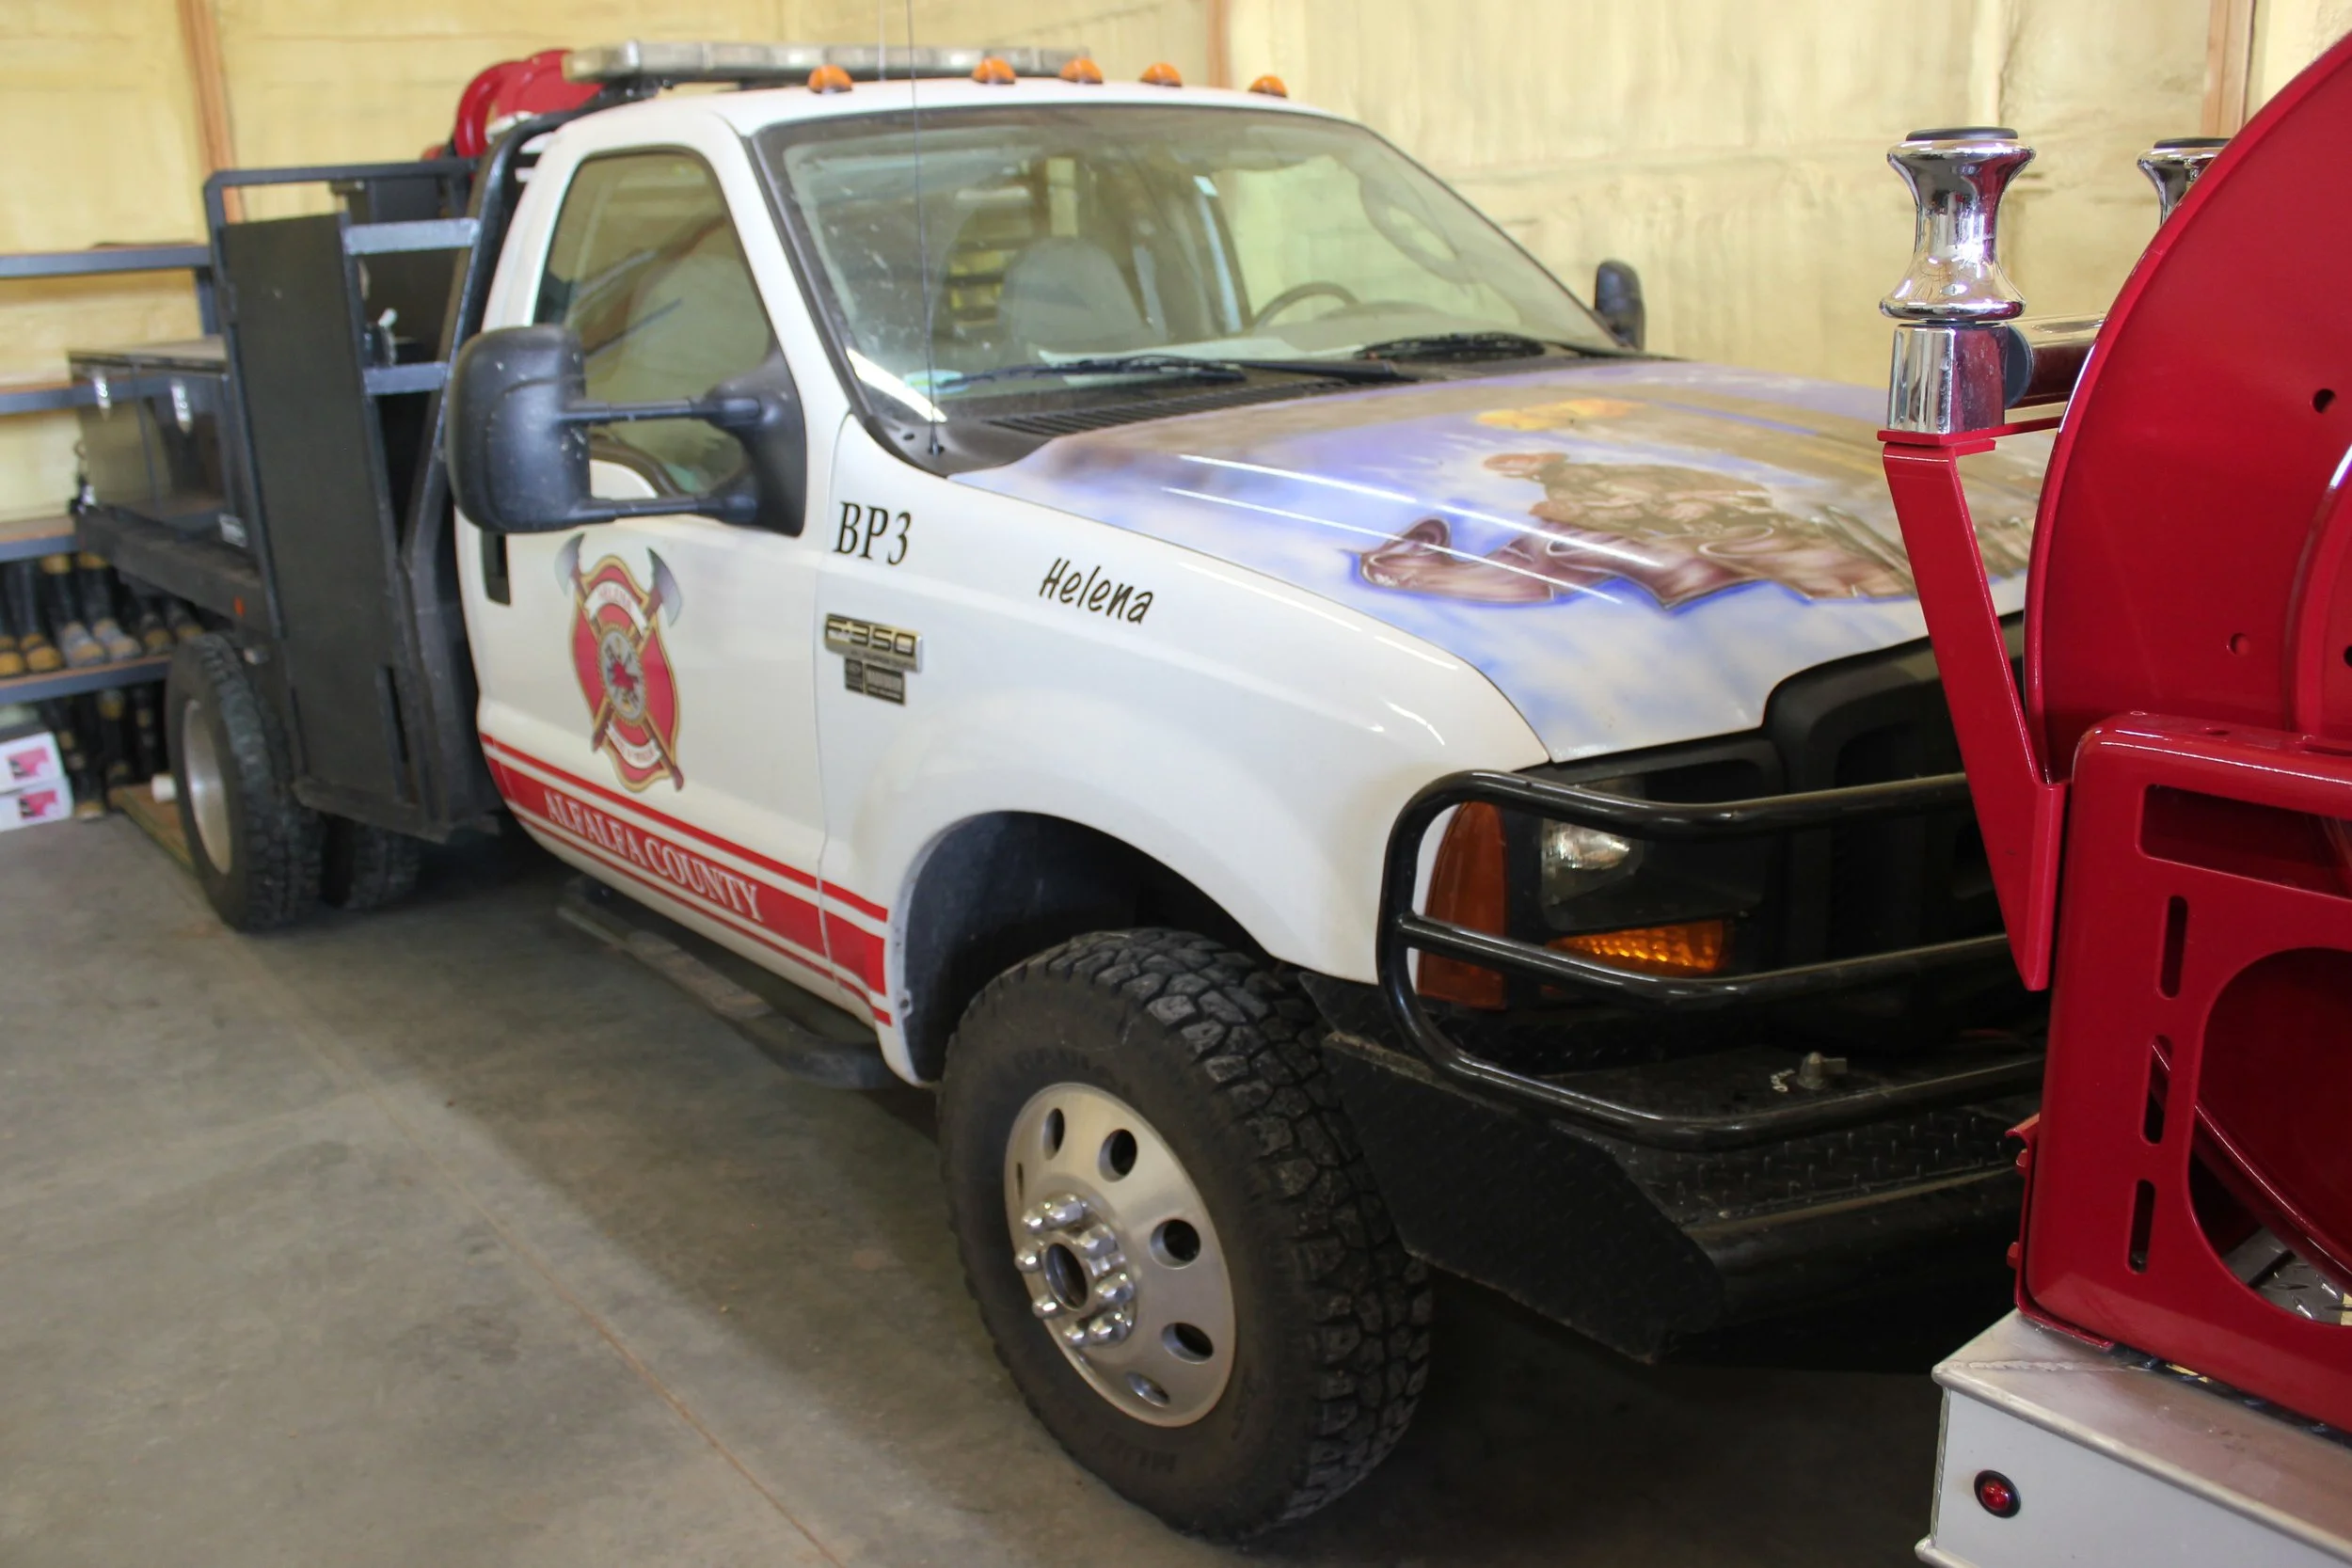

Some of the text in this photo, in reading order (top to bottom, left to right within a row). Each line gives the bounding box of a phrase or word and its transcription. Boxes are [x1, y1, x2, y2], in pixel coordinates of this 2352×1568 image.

[833, 500, 913, 565] BP3
[1039, 557, 1154, 625] Helena
[825, 617, 916, 656] F-350
[544, 790, 763, 922] ALFALFA COUNTY
